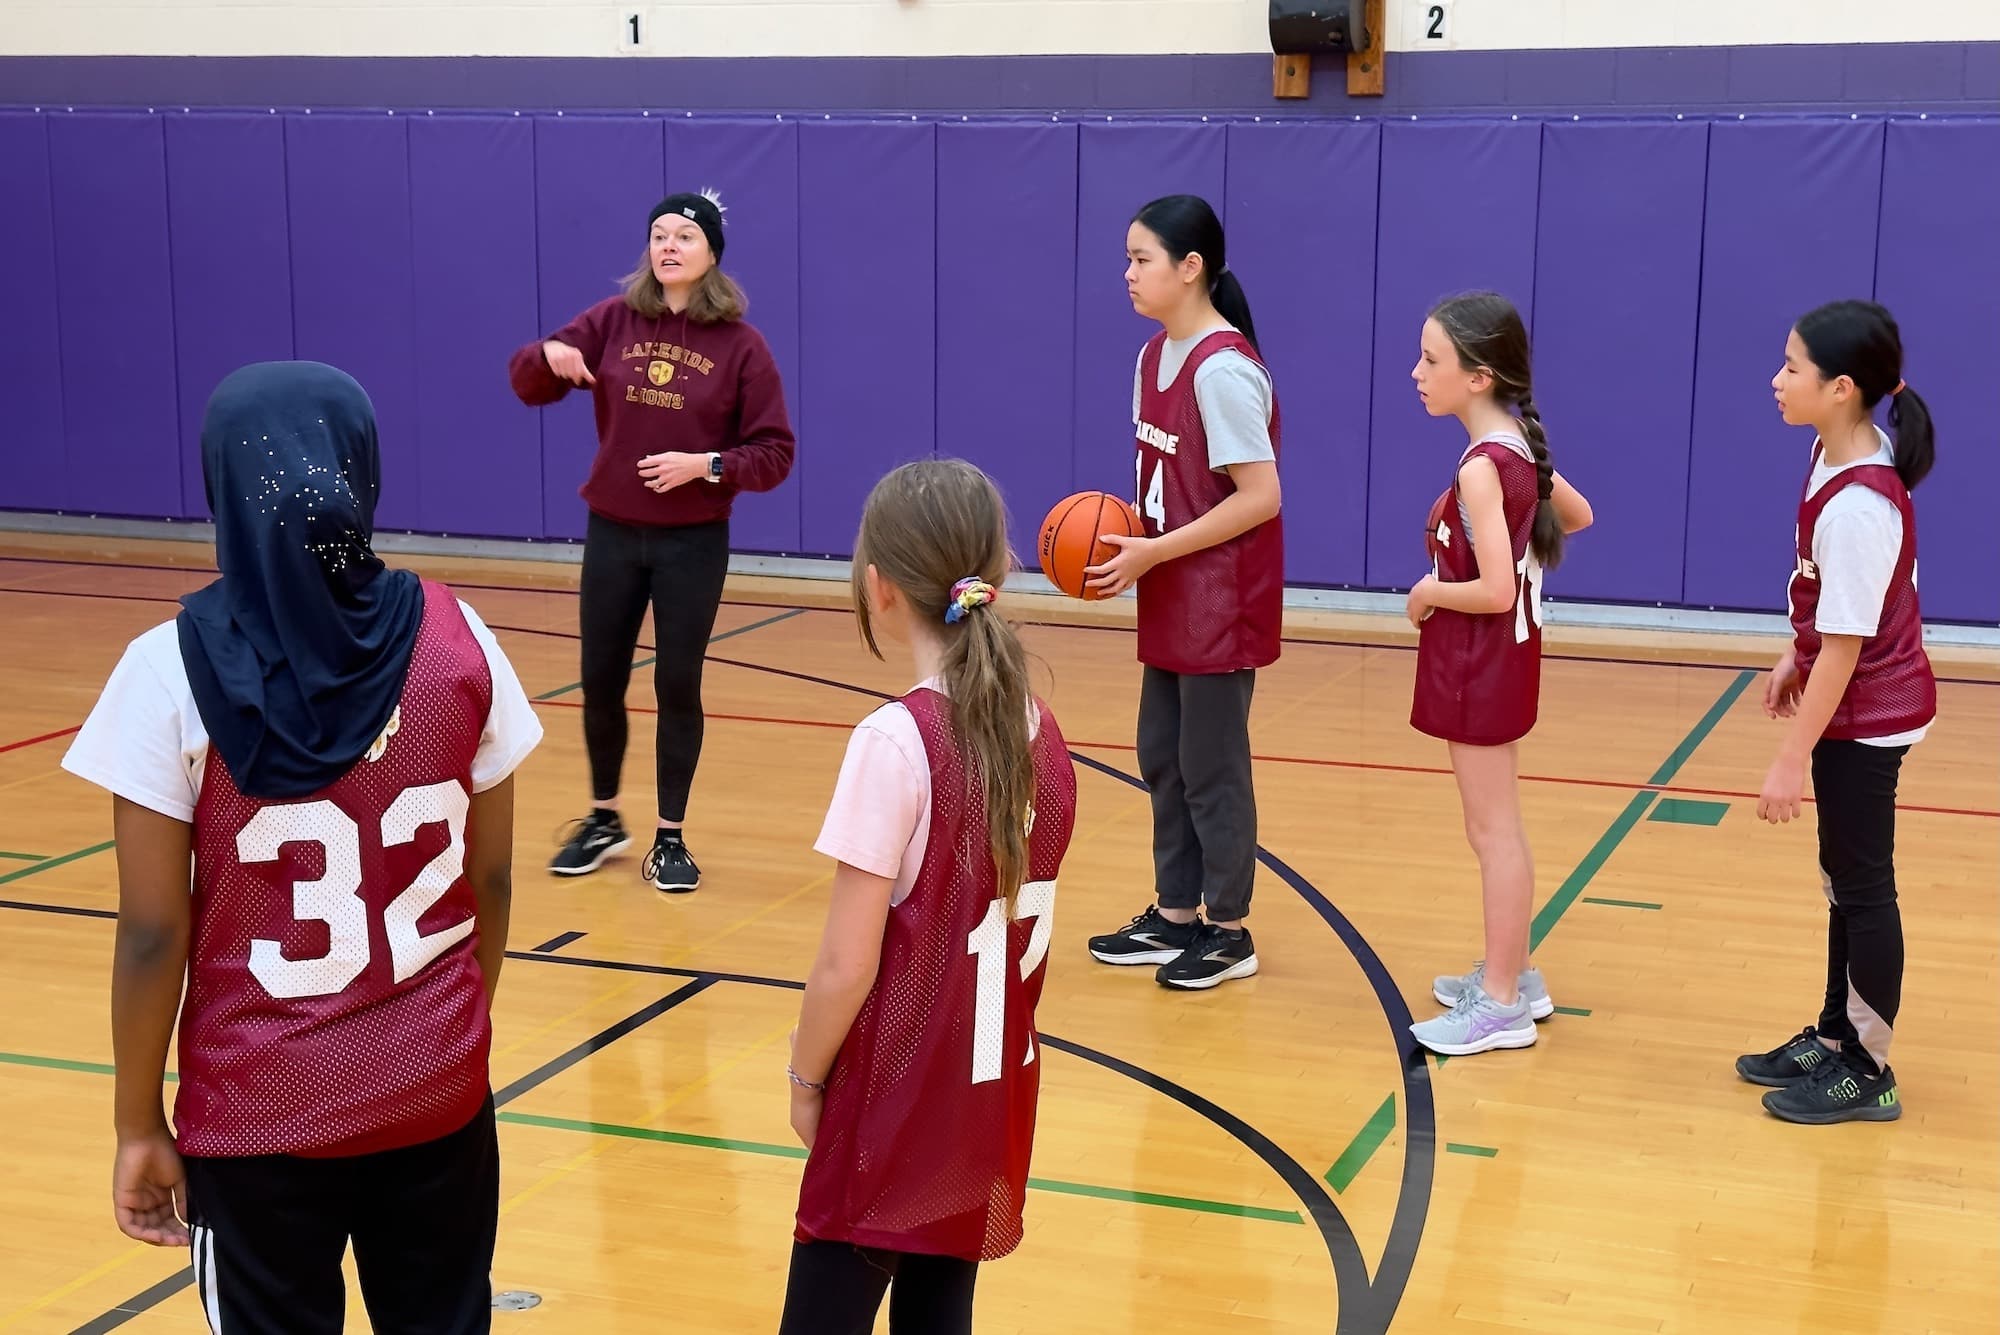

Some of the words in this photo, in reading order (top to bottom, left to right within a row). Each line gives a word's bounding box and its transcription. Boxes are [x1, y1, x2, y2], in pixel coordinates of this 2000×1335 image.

[629, 14, 639, 44] 1
[1427, 5, 1444, 39] 2
[622, 341, 715, 376] LAKESIDE
[626, 385, 684, 409] LIONS
[235, 778, 476, 999] 32
[967, 880, 1056, 1085] 17
